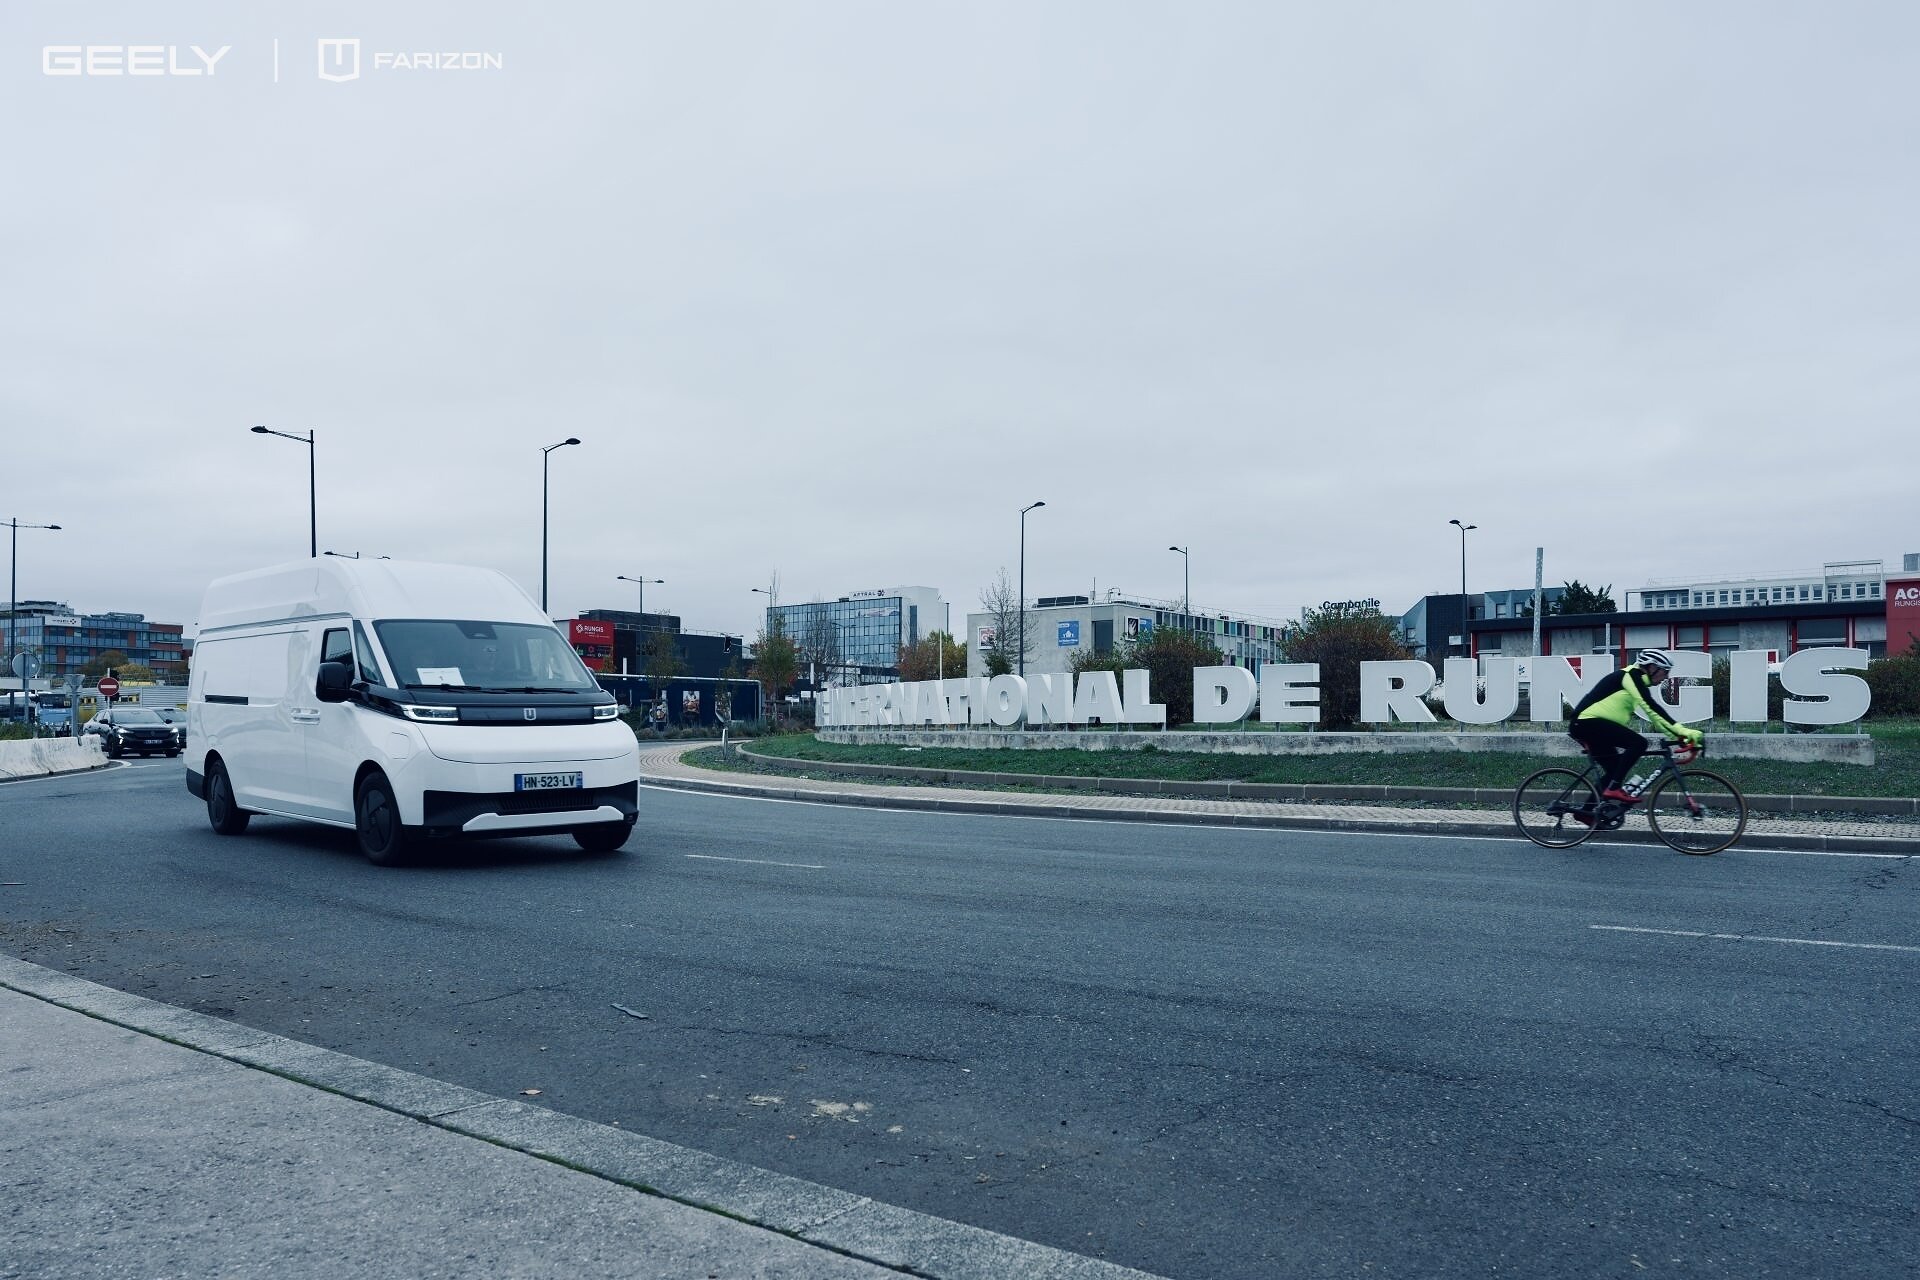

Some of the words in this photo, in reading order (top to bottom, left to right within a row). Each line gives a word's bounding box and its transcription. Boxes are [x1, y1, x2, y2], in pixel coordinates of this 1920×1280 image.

[1895, 587, 1920, 600] AC
[1323, 598, 1380, 610] Campanile
[584, 625, 604, 633] RUNGIS
[831, 668, 1167, 726] INTERNATIONAL
[1193, 662, 1320, 723] DE
[1360, 647, 1872, 725] RUNGIS
[524, 775, 575, 789] HN-523-LV
